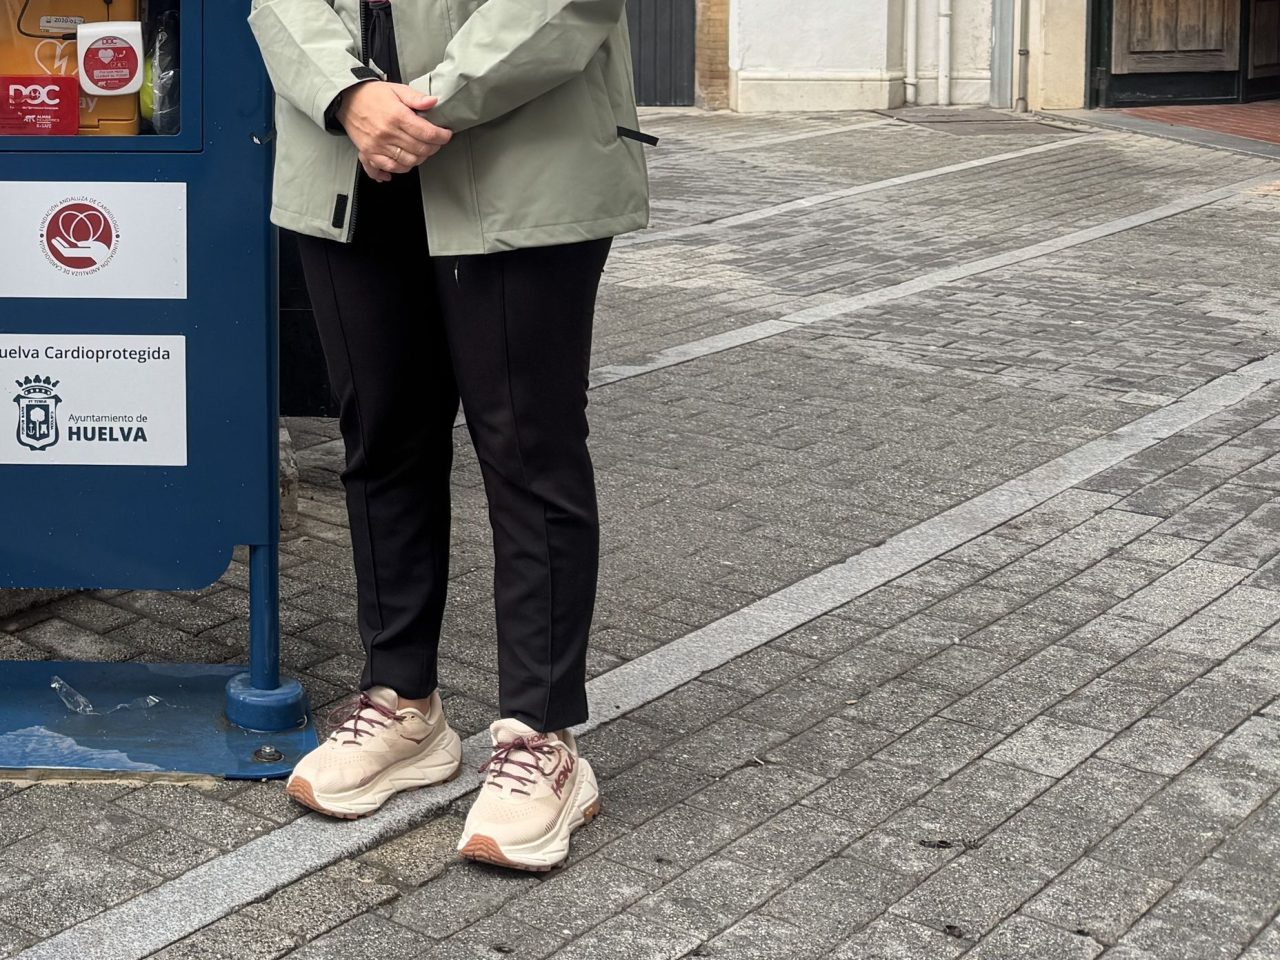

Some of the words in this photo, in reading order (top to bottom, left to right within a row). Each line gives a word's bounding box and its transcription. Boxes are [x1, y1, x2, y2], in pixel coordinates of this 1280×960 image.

[9, 84, 60, 105] DOC
[39, 203, 59, 232] FUNDACIÓN
[59, 196, 88, 205] ANDALUZA
[97, 201, 120, 234] CARDIOLOGÍA
[44, 346, 170, 363] Cardioprotegida
[68, 413, 134, 425] Ayuntamiento
[136, 414, 148, 423] de
[68, 426, 148, 442] HUELVA
[550, 751, 576, 801] HOKA
